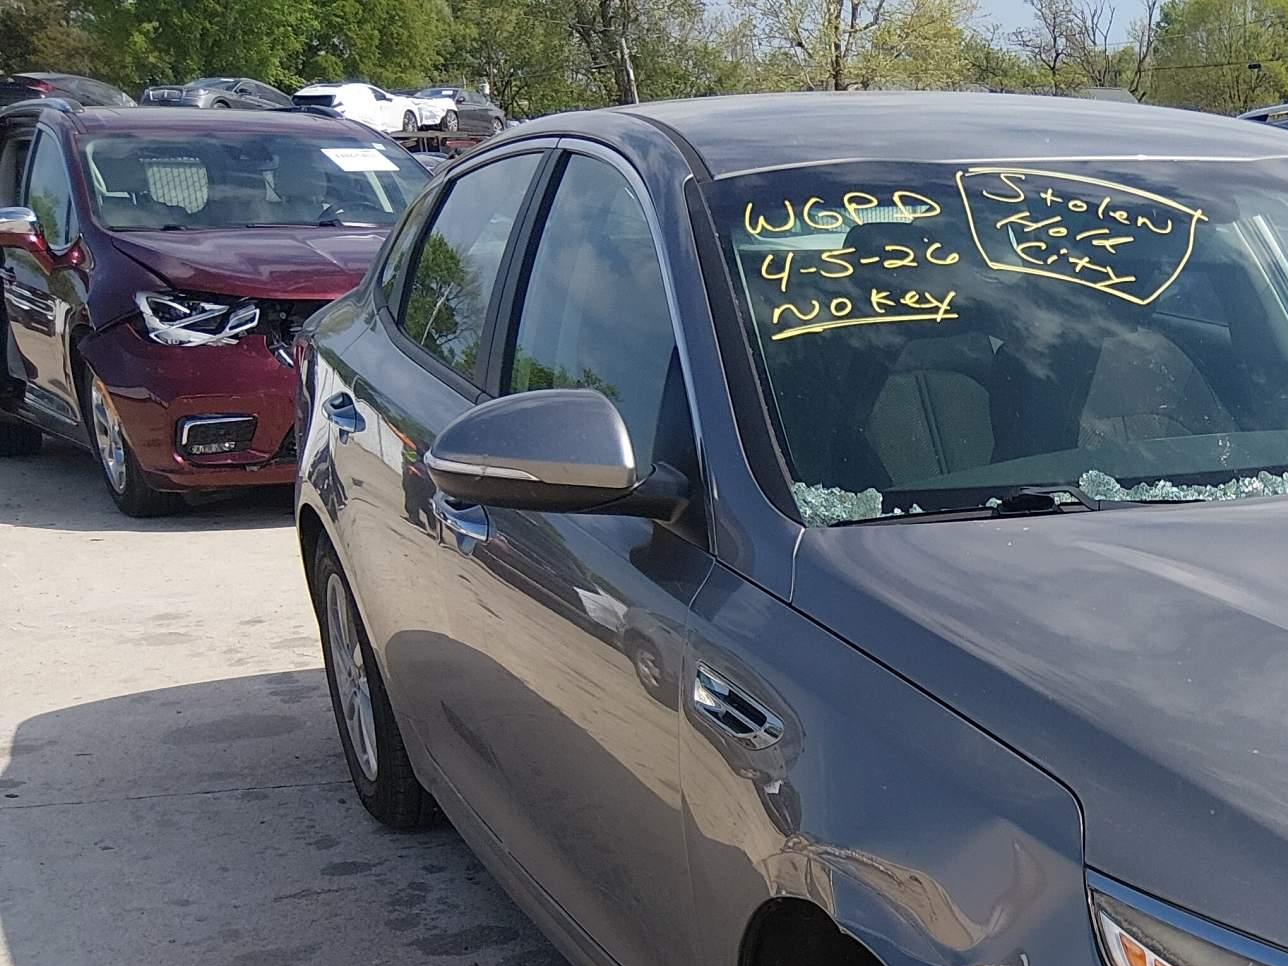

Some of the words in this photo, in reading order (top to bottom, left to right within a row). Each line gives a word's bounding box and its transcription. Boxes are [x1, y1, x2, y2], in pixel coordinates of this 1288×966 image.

[744, 190, 941, 236] WGPD
[982, 173, 1173, 234] Stolen
[761, 240, 961, 291] 4-5-26
